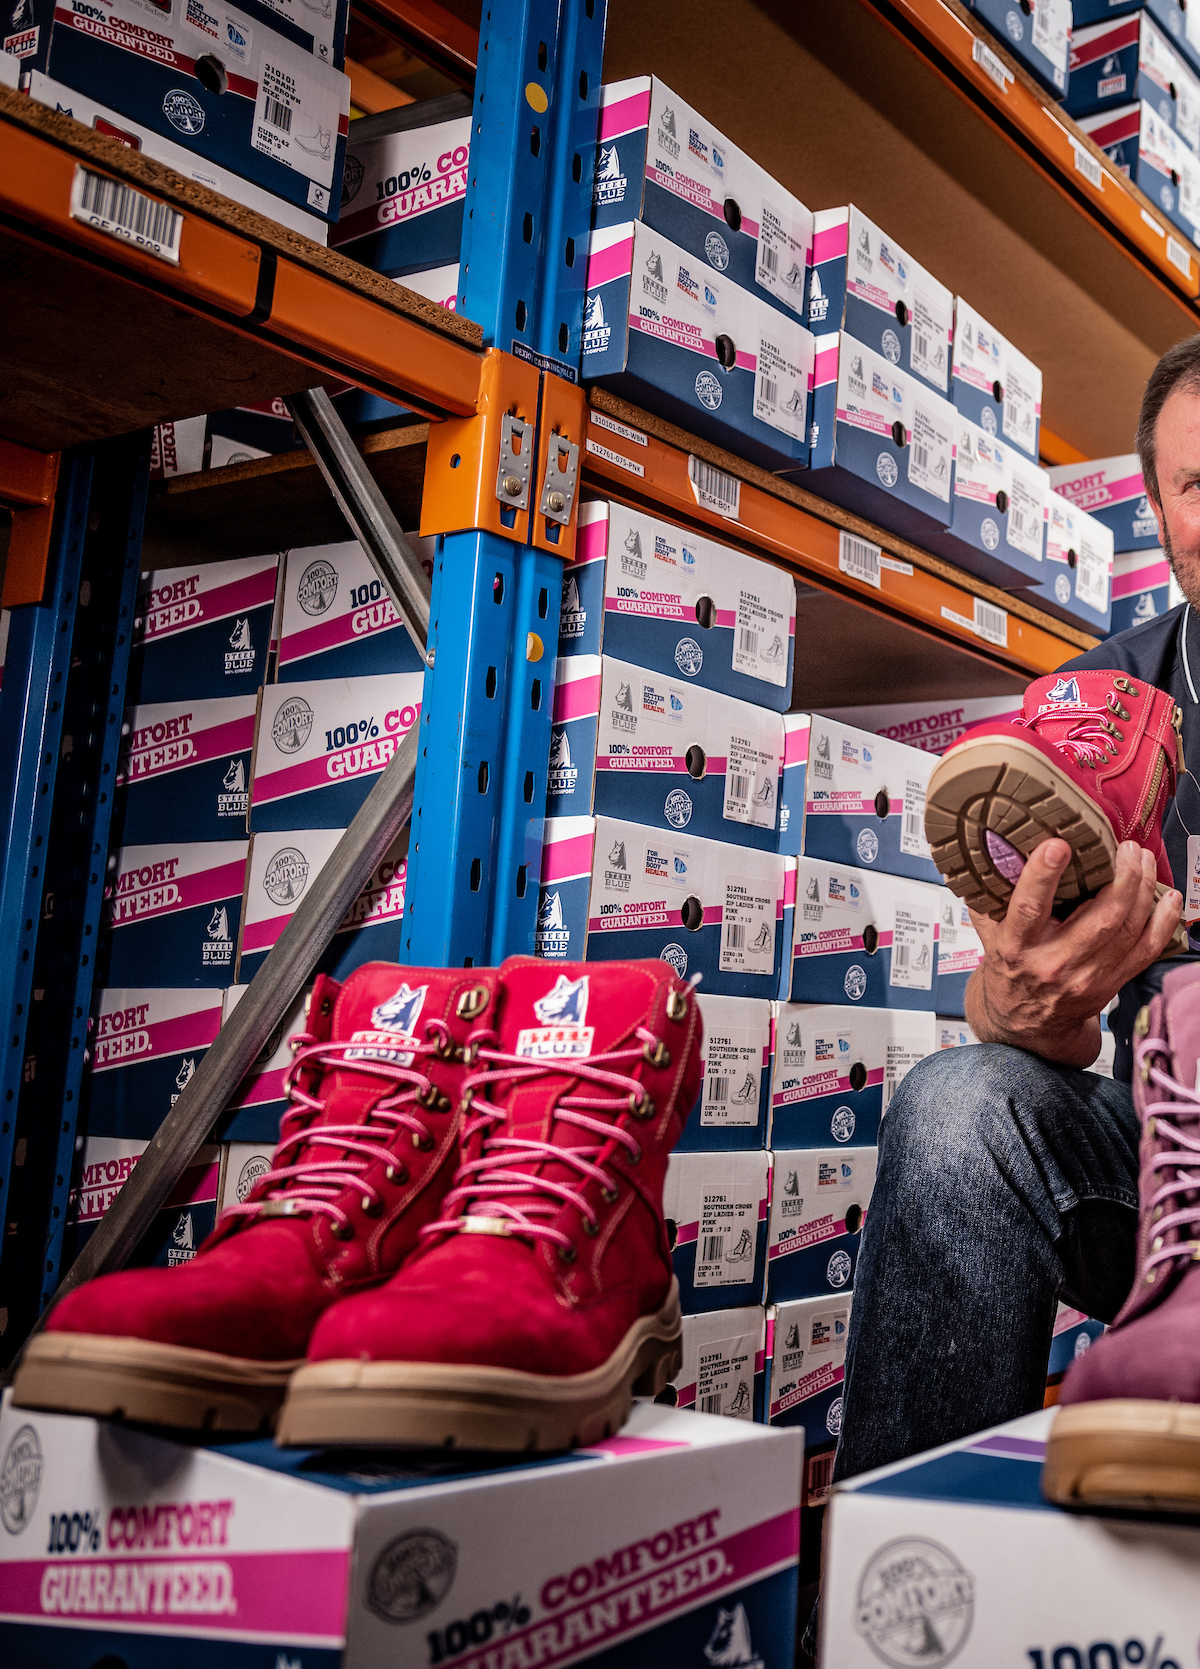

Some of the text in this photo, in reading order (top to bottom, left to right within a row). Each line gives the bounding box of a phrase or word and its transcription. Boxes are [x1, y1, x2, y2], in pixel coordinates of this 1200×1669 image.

[144, 2, 170, 22] Safety
[188, 4, 218, 26] BETTER
[72, 1, 174, 48] 100% COMFORT
[186, 15, 219, 40] HEALTH.
[6, 31, 36, 47] STEEL
[73, 15, 177, 64] GUARANTEED.
[264, 64, 296, 86] 310101
[264, 72, 296, 94] HOBART
[262, 86, 280, 100] SIZE
[274, 83, 301, 105] BROWN
[257, 134, 272, 144] USA
[376, 163, 431, 201] 100%
[655, 159, 674, 176] 100%
[675, 171, 712, 197] COMFORT
[655, 173, 713, 210] GUARANTEED.
[639, 306, 702, 336] 100% COMFORT
[640, 320, 704, 350] GUARANTEED.
[592, 444, 641, 473] 512761-075-PNK
[307, 567, 326, 581] 100%
[297, 573, 339, 598] COMFORT
[617, 587, 681, 604] 100% COMFORT
[617, 600, 684, 617] GUARANTEED.
[225, 651, 255, 660] STEEL
[225, 658, 253, 670] BLUE
[643, 692, 665, 702] BETTER
[644, 685, 654, 693] FOR
[643, 698, 658, 706] BODY
[643, 704, 665, 714] HEALTH.
[271, 710, 314, 739] COMFORT
[612, 720, 637, 731] BLUE
[325, 717, 379, 751] 100%
[731, 736, 751, 747] 512761
[609, 744, 673, 755] 100% COMFORT
[609, 758, 675, 768] GUARANTEED.
[813, 791, 862, 800] 100% COMFORT
[218, 802, 248, 811] BLUE
[646, 862, 661, 870] BODY
[647, 856, 668, 866] BETTER
[264, 862, 309, 890] COMFORT
[645, 868, 669, 877] HEALTH.
[605, 880, 630, 889] BLUE
[727, 885, 747, 893] 512761
[726, 893, 753, 902] SOUTHERN
[600, 901, 667, 914] 100% COMFORT
[600, 913, 669, 929] GUARANTEED.
[800, 928, 851, 941] 100% COMFORT
[203, 942, 233, 951] STEEL
[801, 940, 853, 954] GUARANTEED.
[203, 951, 232, 960] BLUE
[710, 1037, 731, 1045] 512761
[782, 1070, 839, 1089] 100% COMFORT
[783, 1080, 840, 1102] GUARANTEED.
[778, 1214, 833, 1242] 100% COMFORT
[779, 1227, 836, 1254] GUARANTEED.
[700, 1353, 723, 1363] 512761
[700, 1355, 748, 1371] SOUTHERN CROSS
[779, 1362, 833, 1397] 100% COMFORT
[780, 1374, 836, 1409] GUARANTEED.
[47, 1498, 235, 1554] 100% COMFORT
[41, 1561, 237, 1615] GUARANTEED.
[427, 1591, 532, 1666] 100%
[540, 1507, 721, 1611] COMFORT
